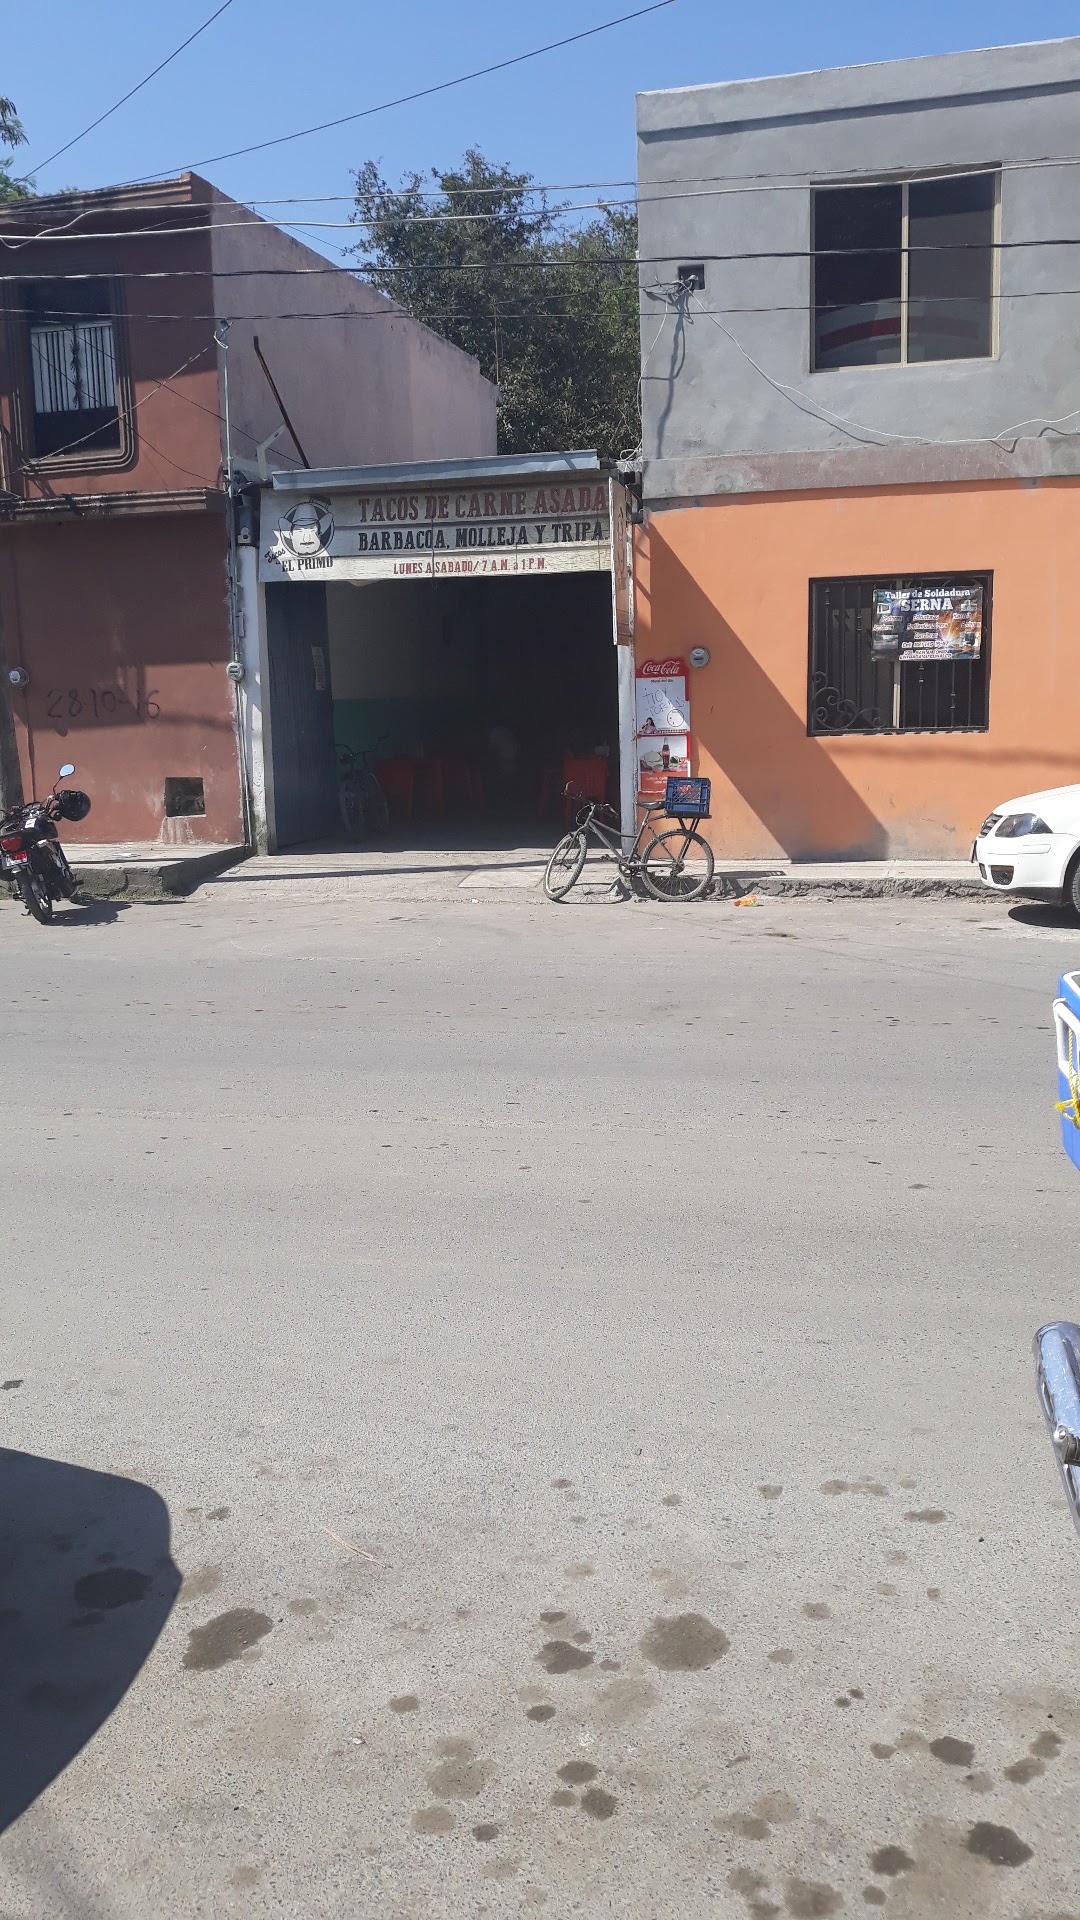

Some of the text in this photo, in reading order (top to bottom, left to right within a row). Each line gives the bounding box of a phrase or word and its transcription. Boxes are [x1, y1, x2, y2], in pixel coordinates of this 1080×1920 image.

[358, 485, 608, 523] TACOS DE CARNE ASADA
[358, 529, 450, 552] BARBACOA,
[455, 525, 529, 548] MOLLEJA
[534, 524, 547, 544] Y
[263, 547, 286, 564] Tacos
[393, 562, 424, 575] LUNES
[884, 587, 971, 600] Taller de Soldadura
[900, 597, 954, 612] SERNA
